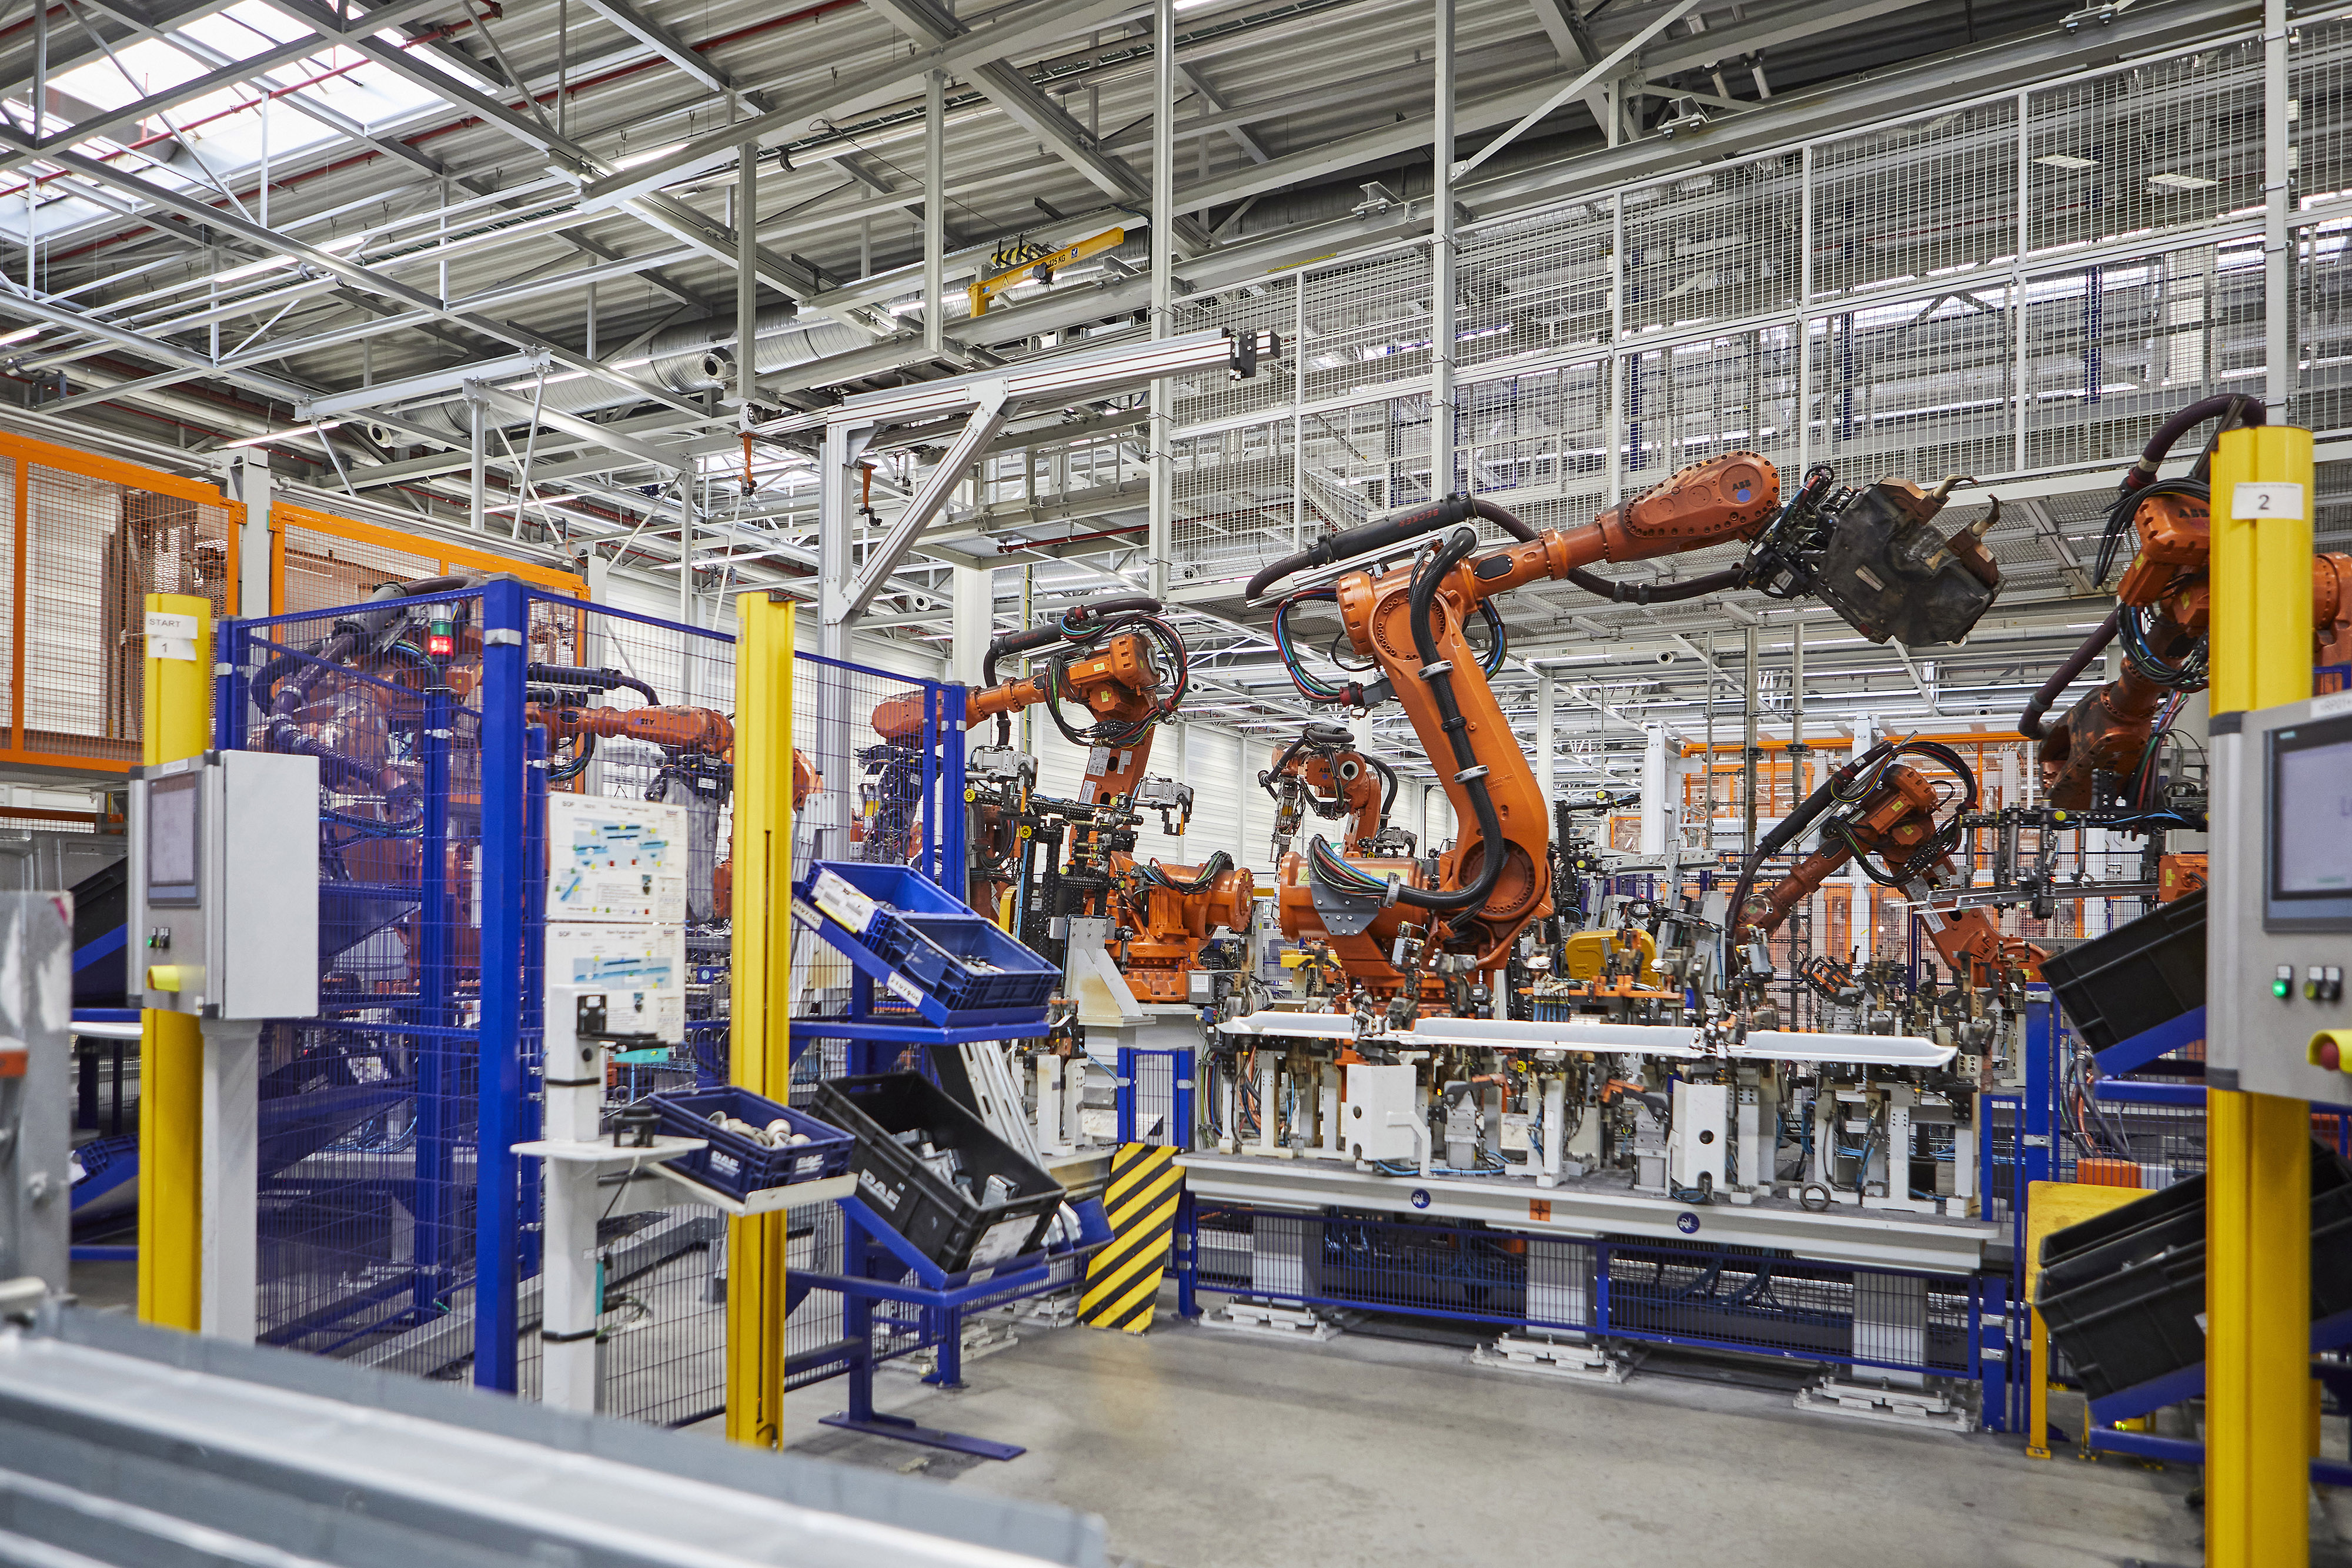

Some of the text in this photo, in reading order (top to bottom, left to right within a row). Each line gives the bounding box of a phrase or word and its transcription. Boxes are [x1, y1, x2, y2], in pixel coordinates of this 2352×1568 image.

[1058, 254, 1065, 263] KG
[1732, 480, 1751, 491] ABB
[2259, 494, 2270, 510] 2
[1399, 508, 1439, 527] BECKER
[149, 618, 181, 627] START
[162, 643, 167, 653] 1
[711, 1150, 739, 1168] DAF
[796, 1154, 823, 1167] DAF
[860, 1168, 901, 1205] DAF
